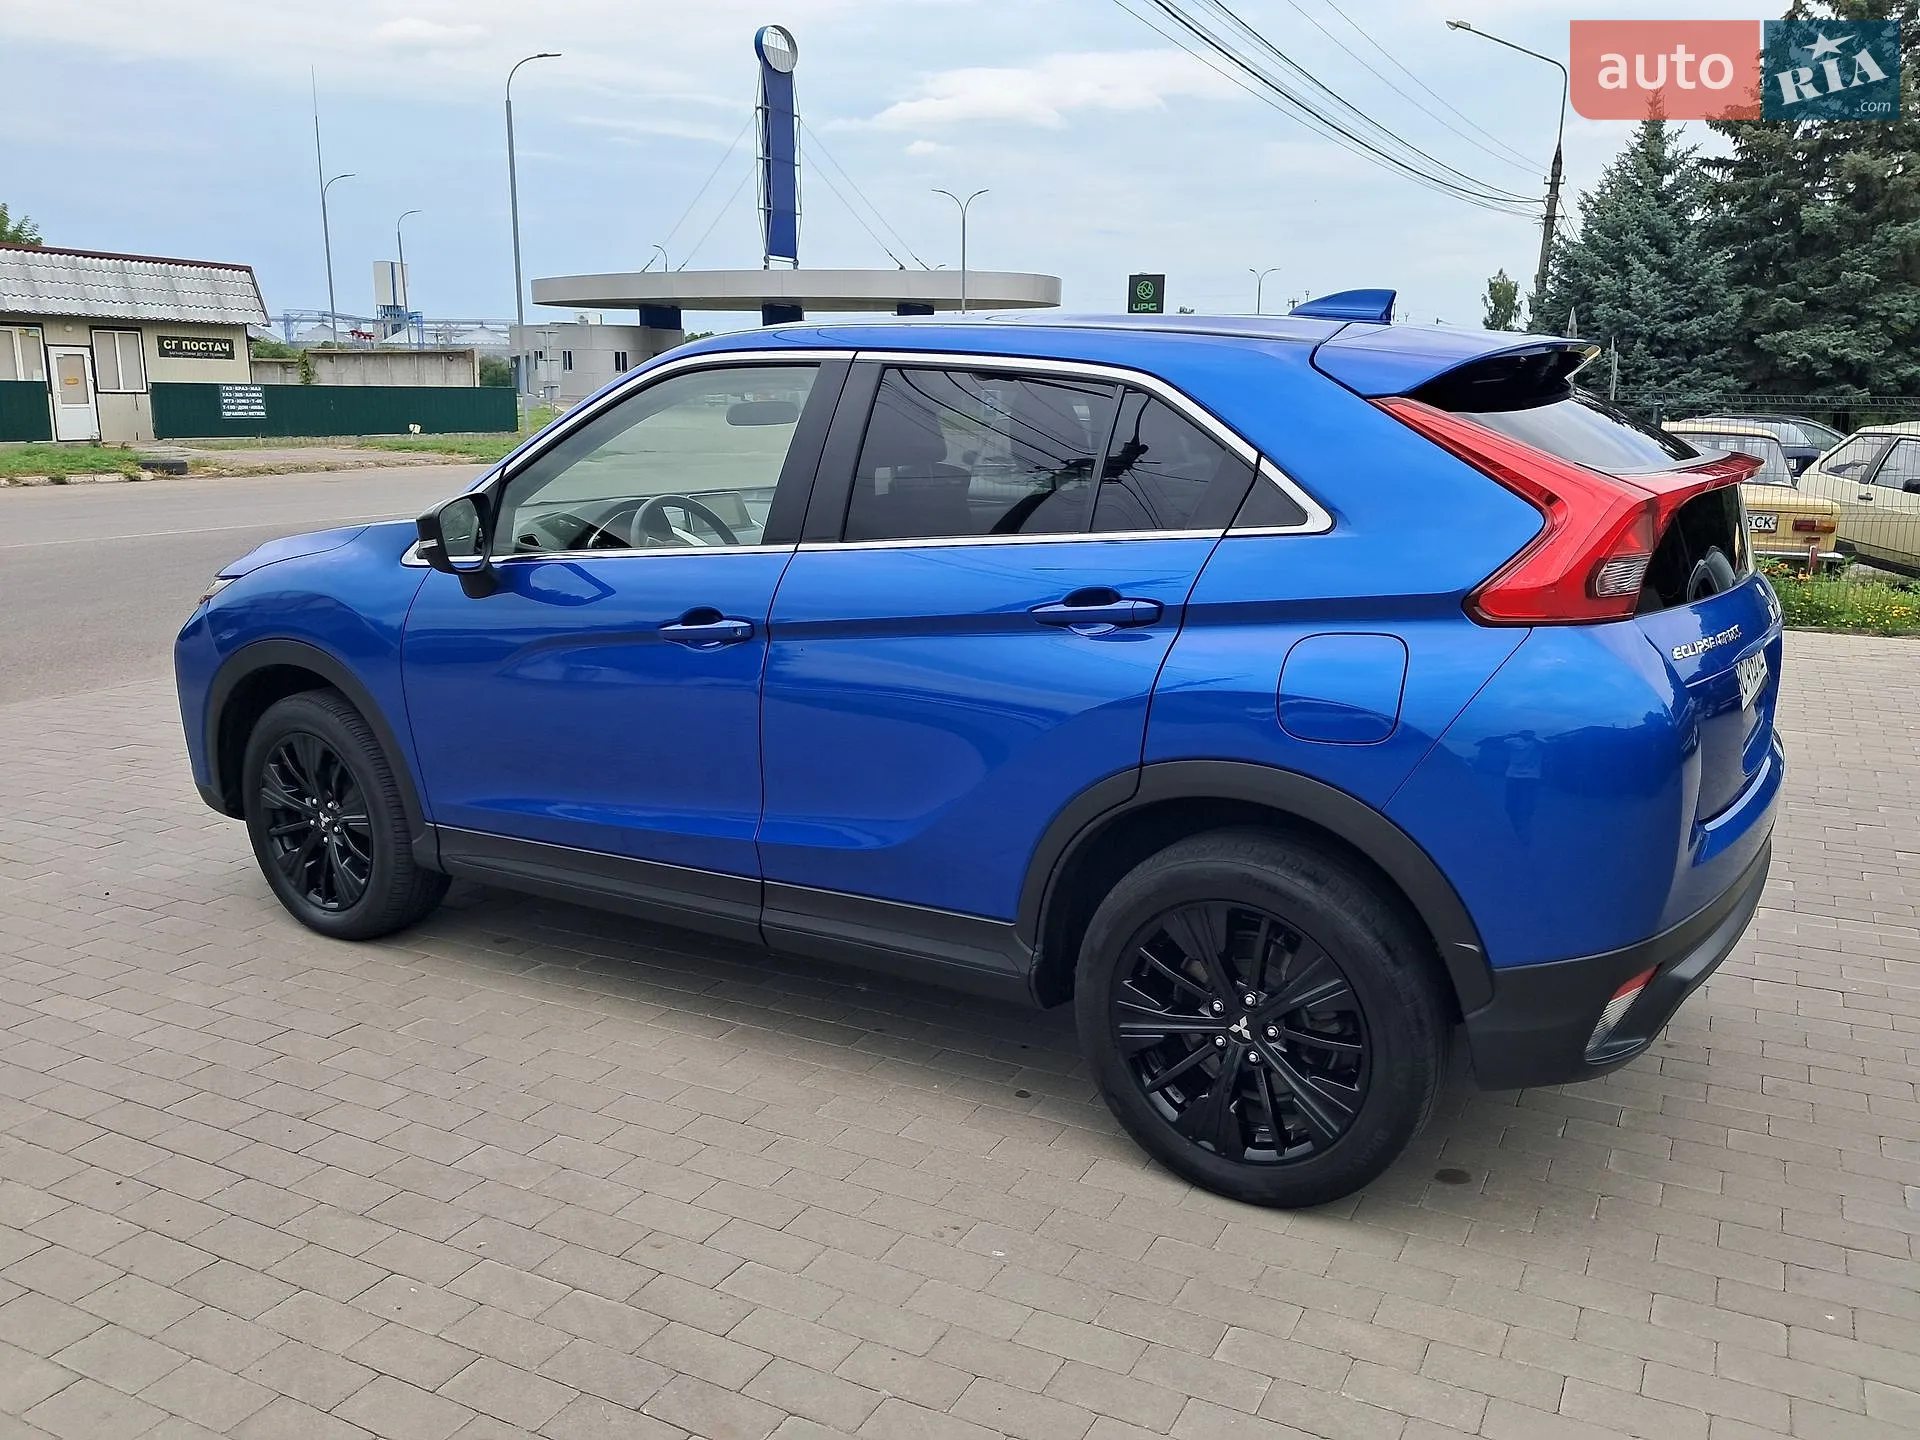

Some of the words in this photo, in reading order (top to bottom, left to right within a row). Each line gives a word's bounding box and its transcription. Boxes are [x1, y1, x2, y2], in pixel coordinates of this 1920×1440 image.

[1132, 303, 1157, 311] UPG
[163, 340, 178, 350] СГ
[182, 340, 230, 352] ПОСТАЧ
[1673, 636, 1715, 659] ECLIPSE
